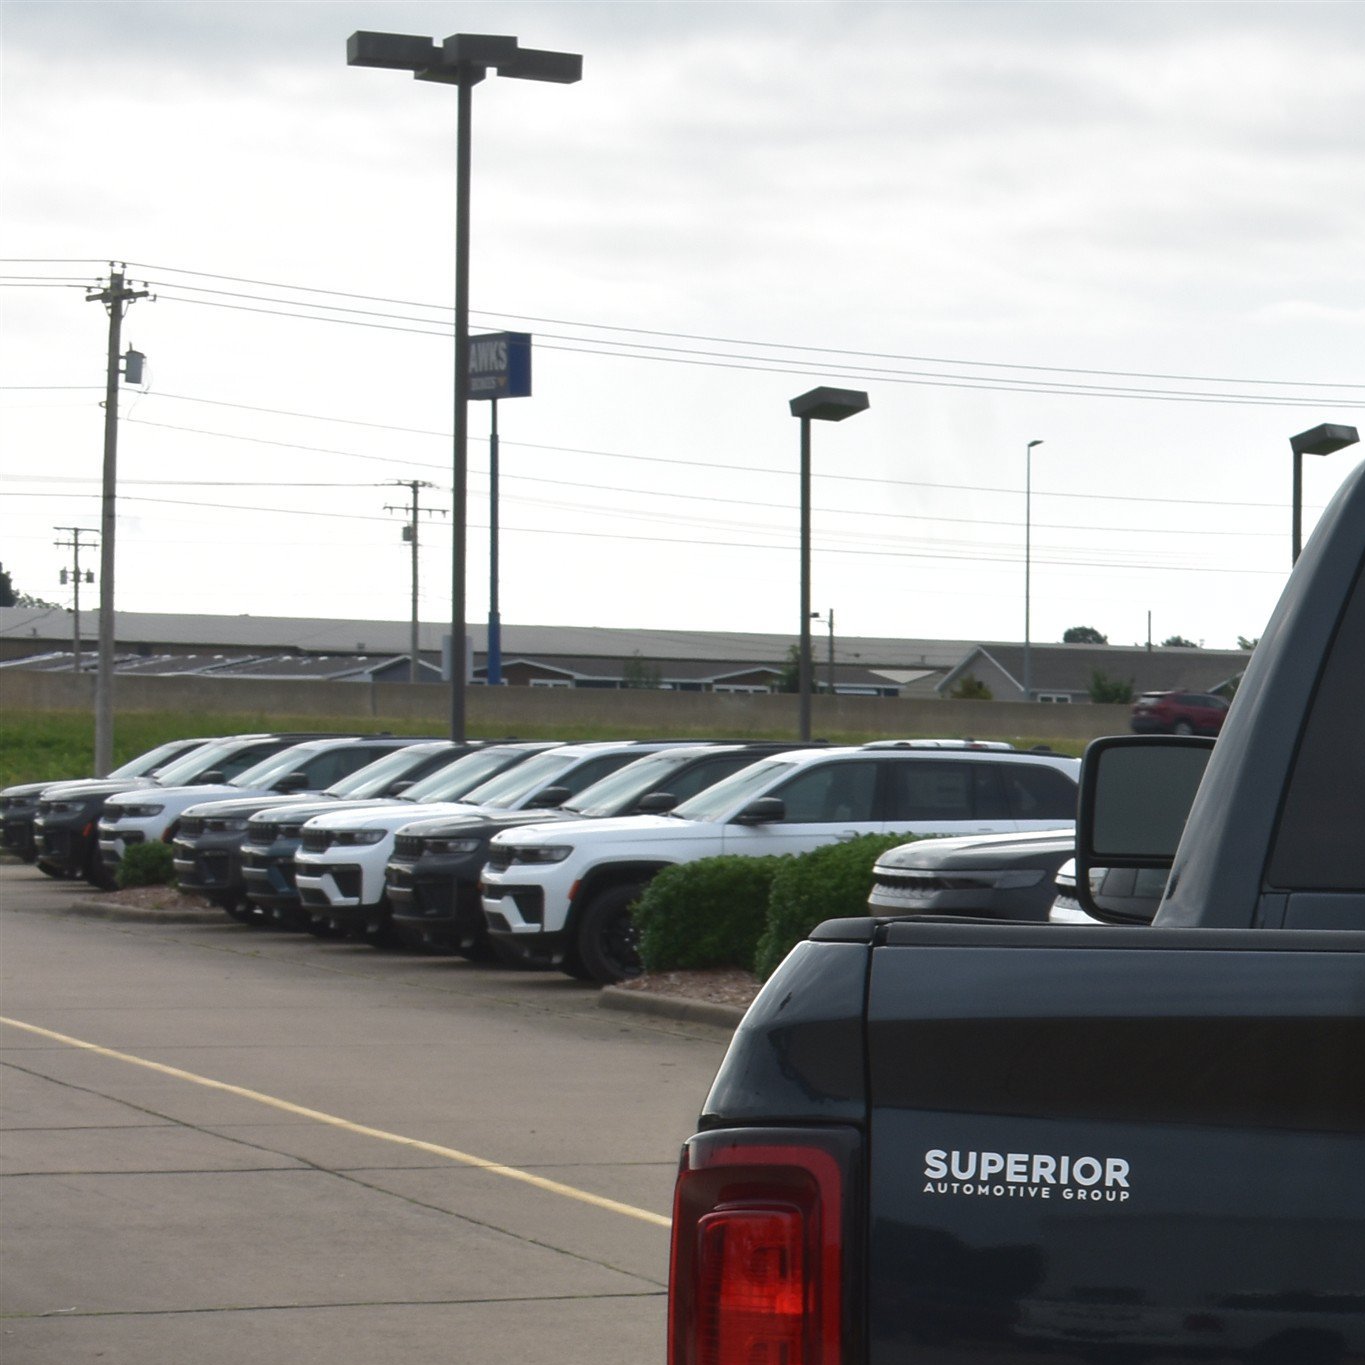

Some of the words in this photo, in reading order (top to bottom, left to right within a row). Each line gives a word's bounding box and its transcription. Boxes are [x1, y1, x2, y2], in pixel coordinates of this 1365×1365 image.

[923, 1149, 1131, 1188] SUPERIOR
[923, 1181, 1051, 1199] AUTOMOTIVE
[1062, 1187, 1131, 1202] GROUP
